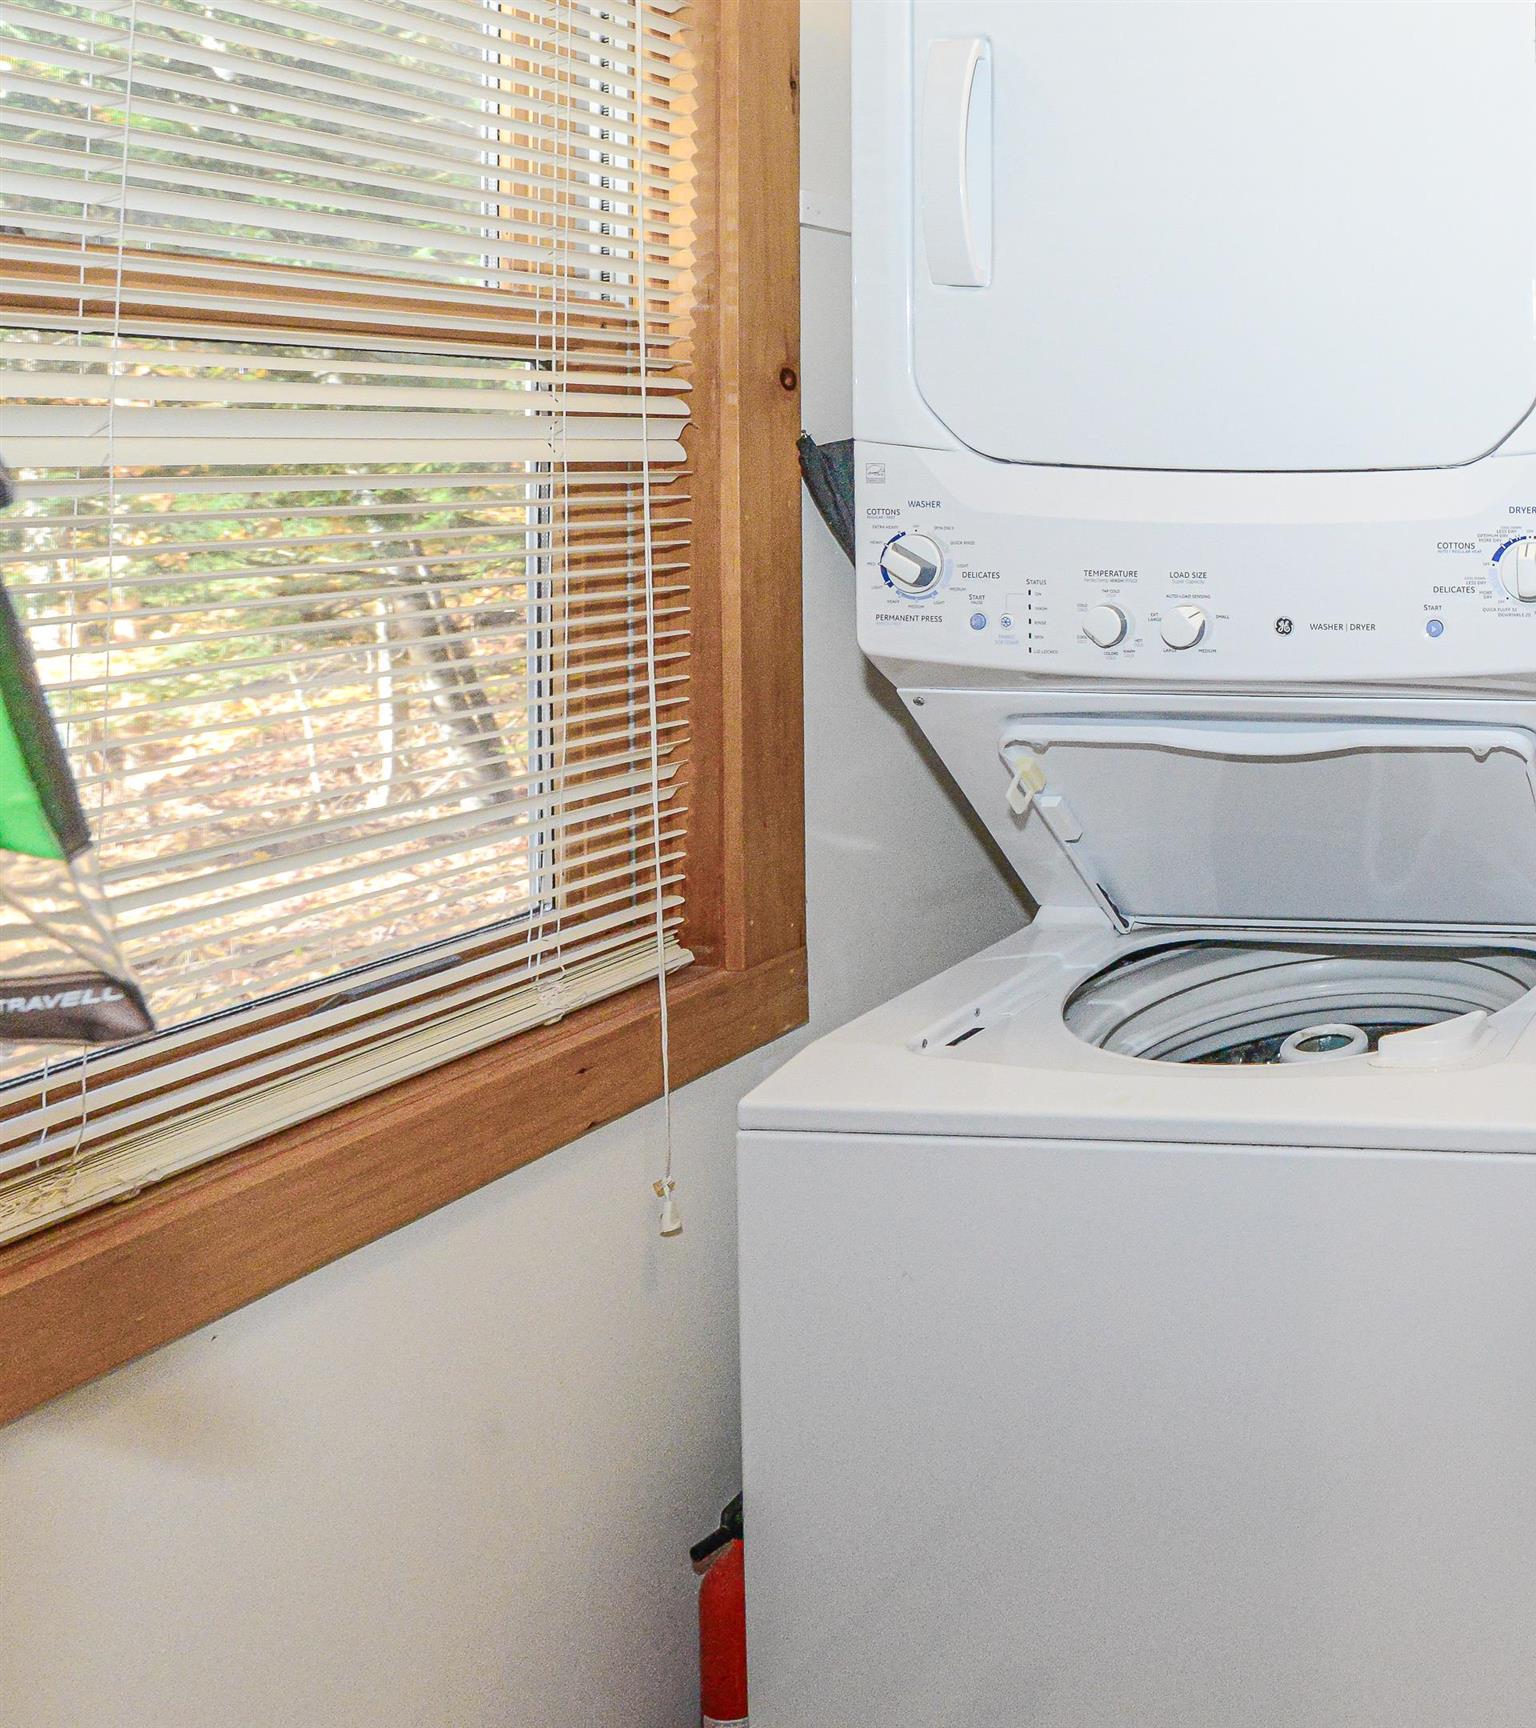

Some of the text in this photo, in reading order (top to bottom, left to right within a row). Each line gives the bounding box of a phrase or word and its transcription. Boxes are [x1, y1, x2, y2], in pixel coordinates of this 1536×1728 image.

[907, 500, 942, 509] WASHER
[866, 508, 901, 516] COTTONS
[1508, 506, 1536, 514] DRYER
[1436, 541, 1476, 550] COTTONS
[961, 571, 1001, 579] DELICATES
[1083, 569, 1139, 578] TEMPERATURE
[1169, 571, 1207, 579] LOAD SIZE
[1432, 585, 1476, 594] DELICATES
[968, 593, 986, 601] START
[875, 613, 943, 623] PERMANENT PRESS
[1309, 623, 1376, 632] WASHER DRYER
